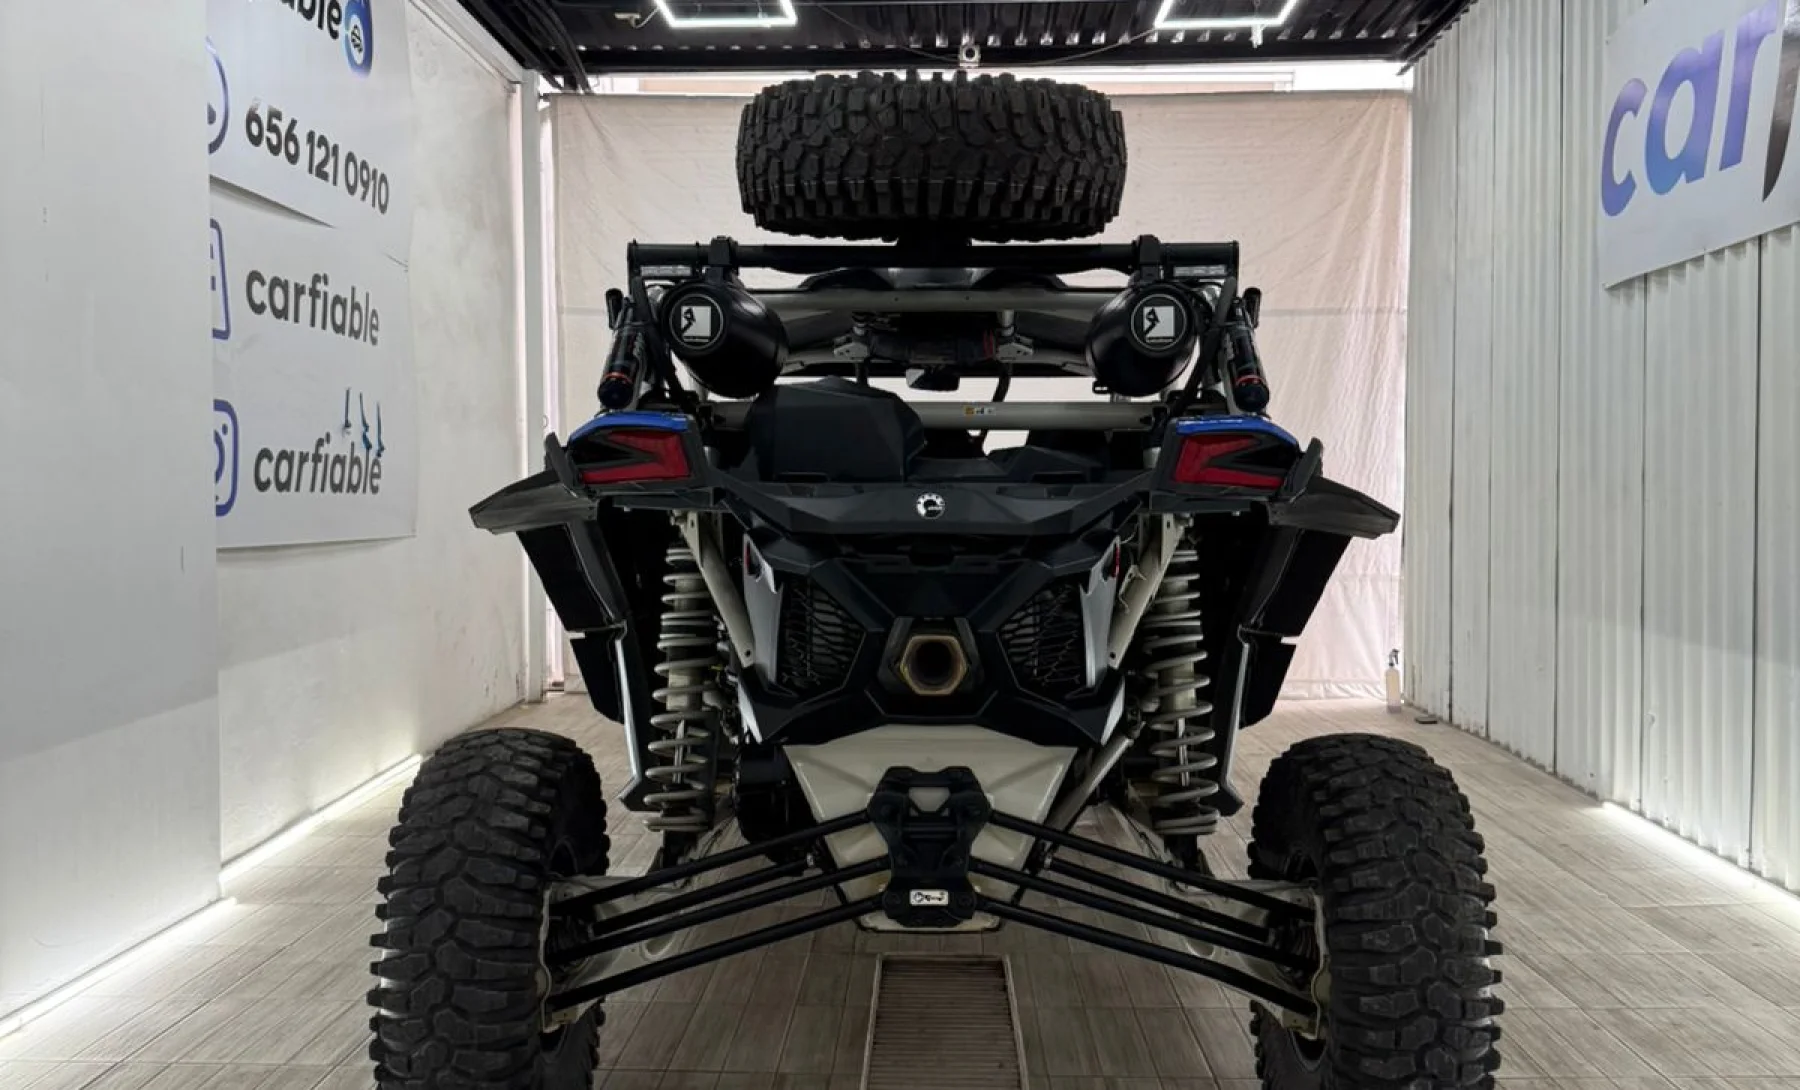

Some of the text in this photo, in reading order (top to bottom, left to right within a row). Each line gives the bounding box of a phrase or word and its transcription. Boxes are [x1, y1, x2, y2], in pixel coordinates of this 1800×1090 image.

[245, 98, 390, 215] 656 121 0910
[245, 269, 380, 346] carfiable
[253, 431, 383, 495] carfiable
